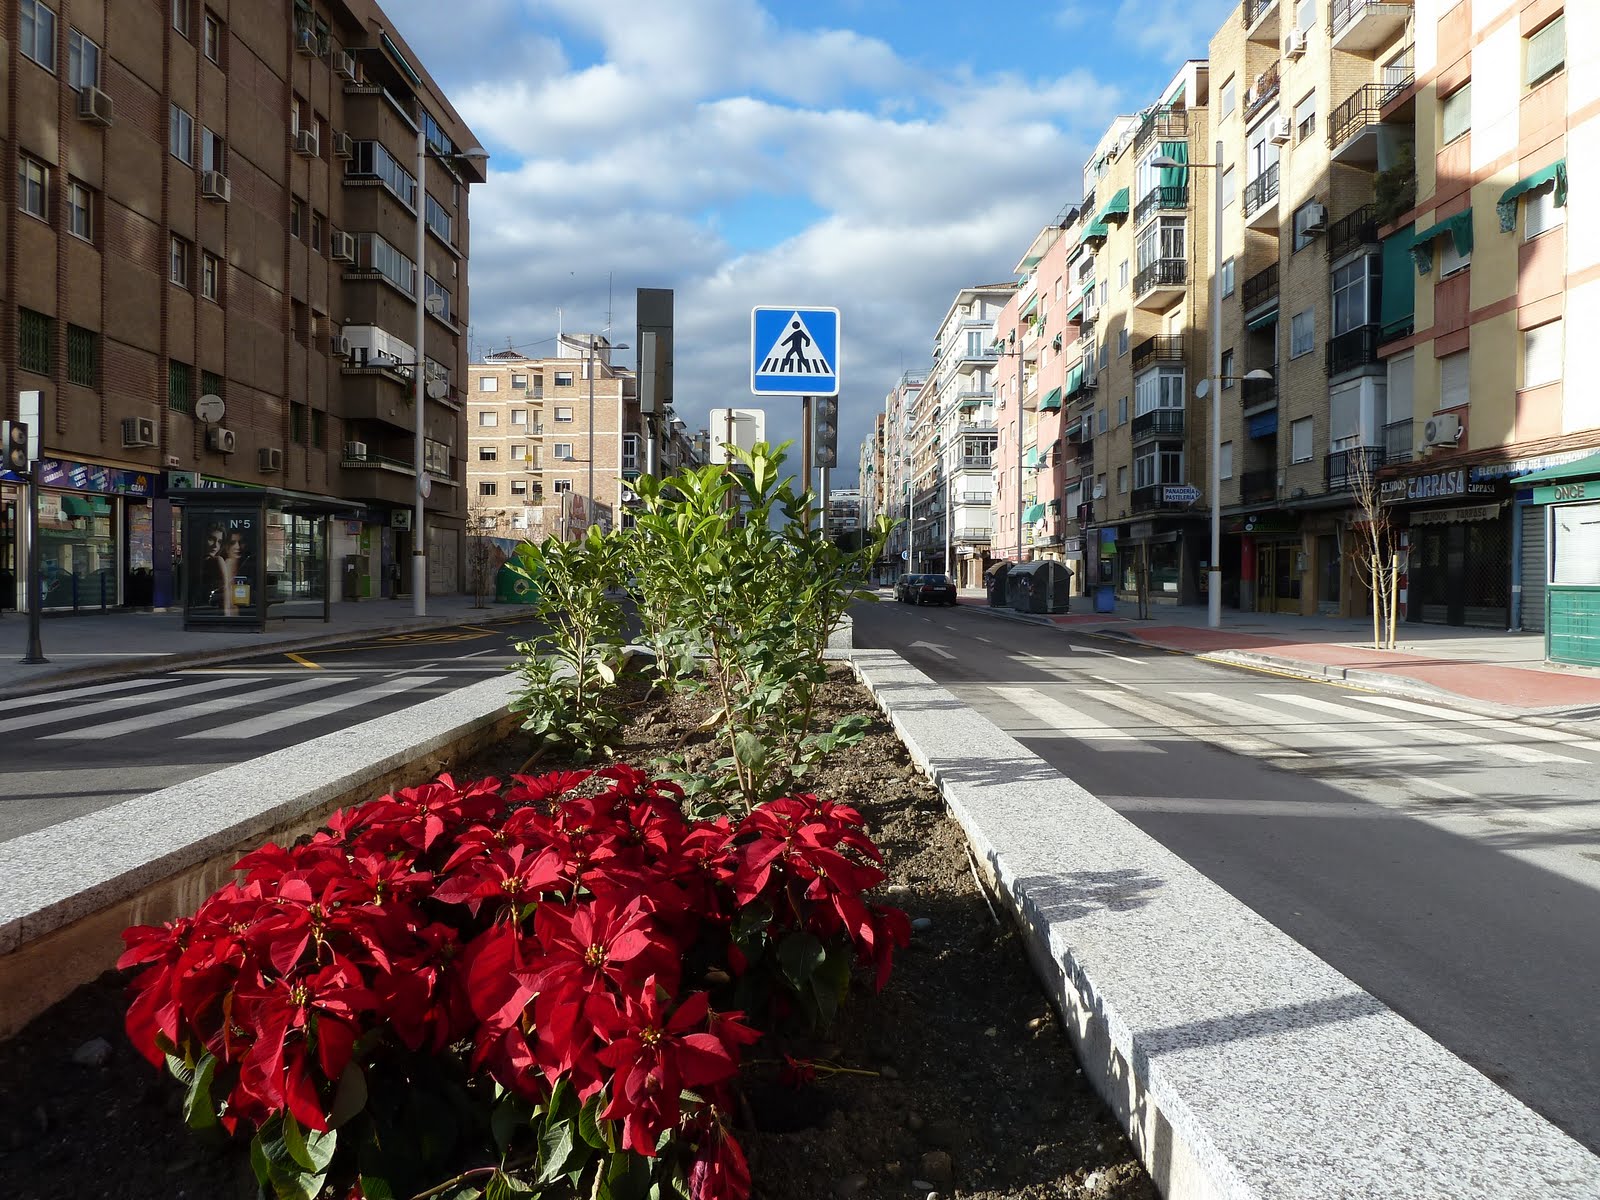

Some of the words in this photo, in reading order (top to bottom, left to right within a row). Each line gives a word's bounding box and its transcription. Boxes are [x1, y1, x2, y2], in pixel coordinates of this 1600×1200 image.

[1478, 459, 1526, 477] ELECTRICIDAD
[1528, 458, 1542, 469] DEL
[1407, 470, 1464, 499] TARRASA
[1554, 483, 1585, 500] ONCE
